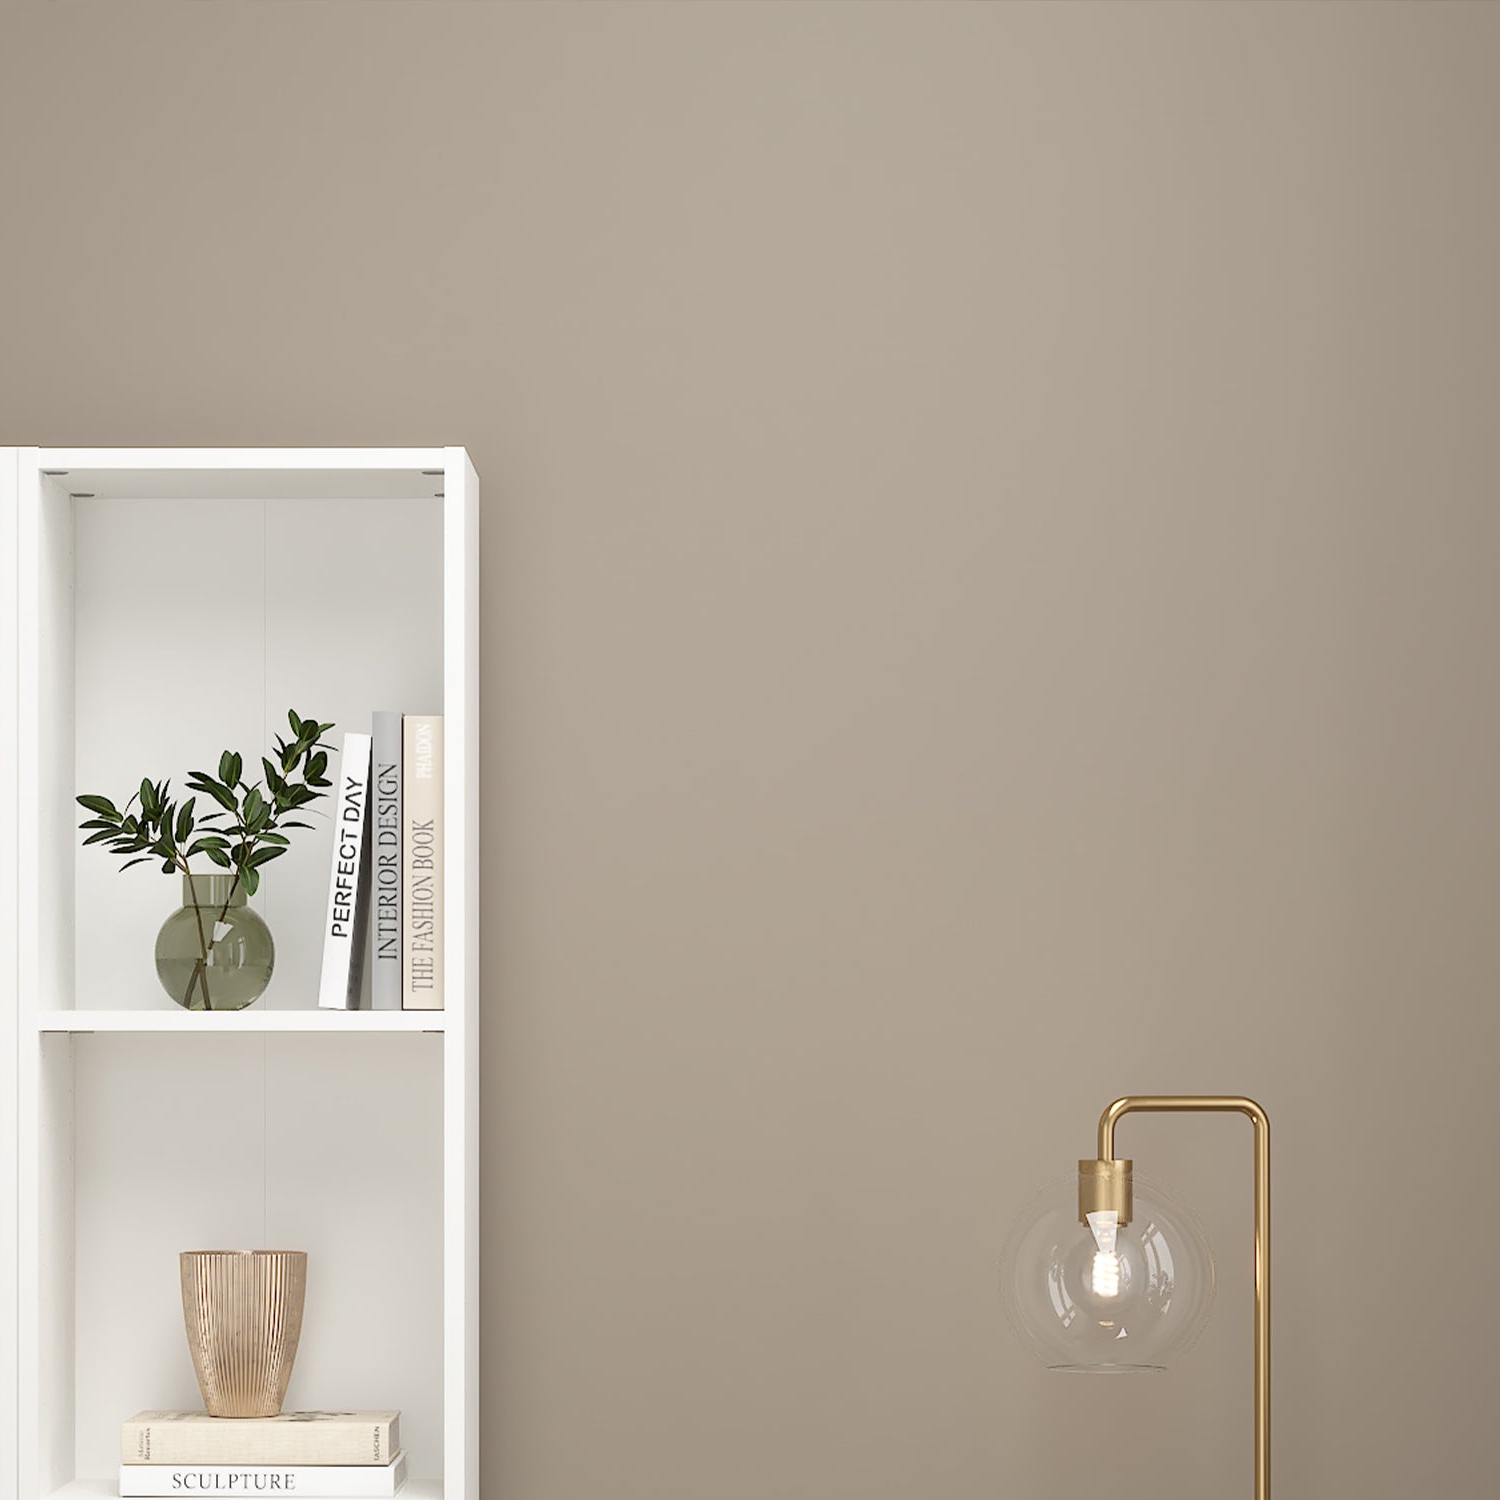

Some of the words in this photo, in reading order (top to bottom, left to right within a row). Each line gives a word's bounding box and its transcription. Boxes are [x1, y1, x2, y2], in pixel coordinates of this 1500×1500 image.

[415, 723, 432, 779] PHAIDON
[343, 777, 364, 821] DAY
[378, 764, 398, 846] DESIGN
[412, 819, 434, 873] BOOK
[332, 829, 359, 938] PERFECT
[378, 853, 398, 960] INTERIOR
[412, 876, 434, 954] FASHION
[412, 958, 434, 992] THE
[172, 1473, 296, 1490] SCULPTURE
